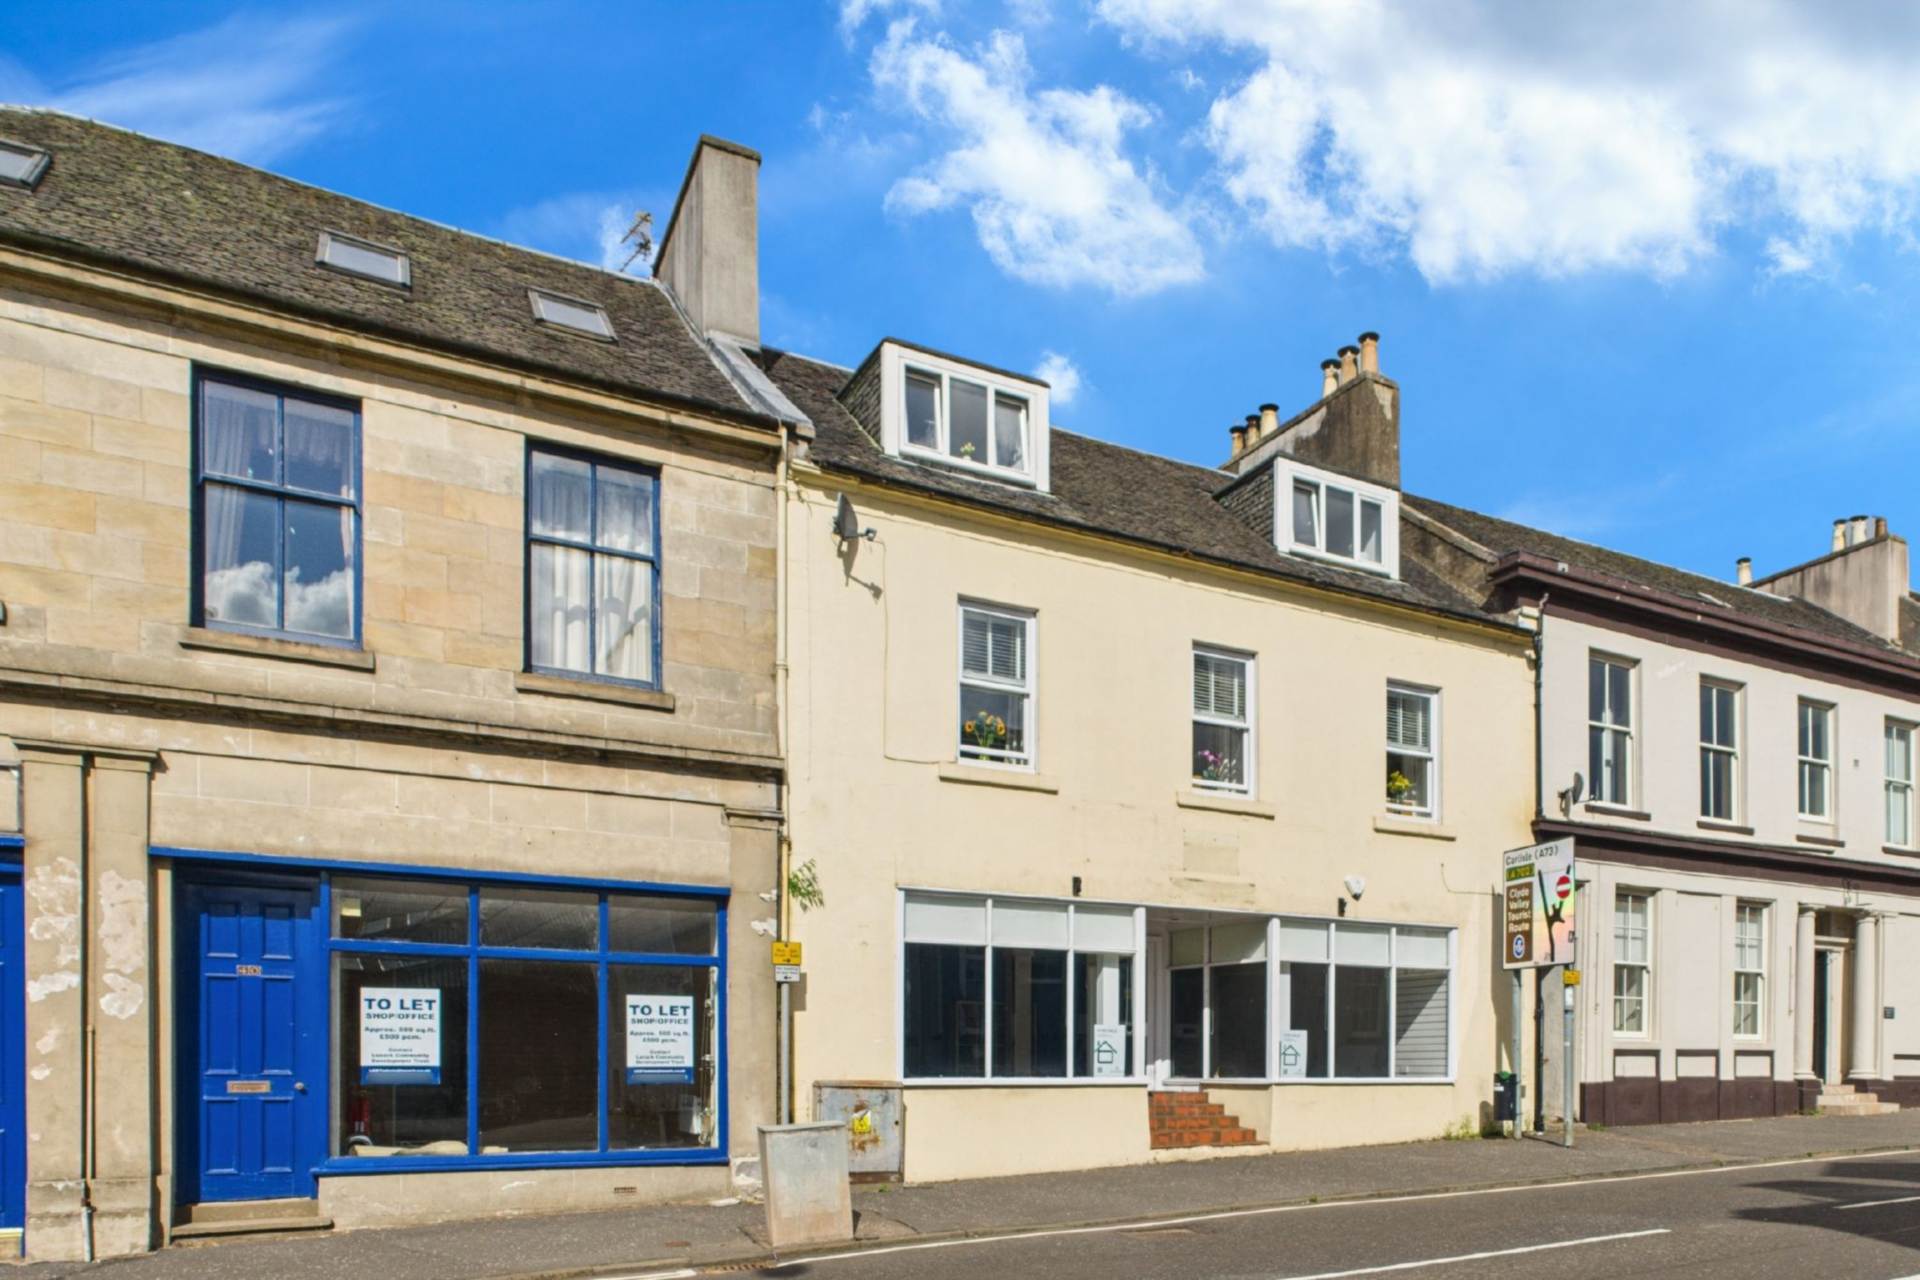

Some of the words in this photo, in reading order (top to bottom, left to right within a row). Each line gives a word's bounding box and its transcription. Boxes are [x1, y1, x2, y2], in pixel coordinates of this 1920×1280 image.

[1505, 853, 1532, 866] Carlisle
[1535, 844, 1559, 860] (A73)
[1509, 887, 1530, 898] Clyde
[1508, 899, 1530, 910] Valley
[1507, 910, 1531, 921] Tourist
[1508, 922, 1530, 933] Route
[364, 998, 391, 1010] TO
[399, 999, 436, 1011] LET
[629, 1004, 652, 1015] TO
[659, 1005, 690, 1016] LET
